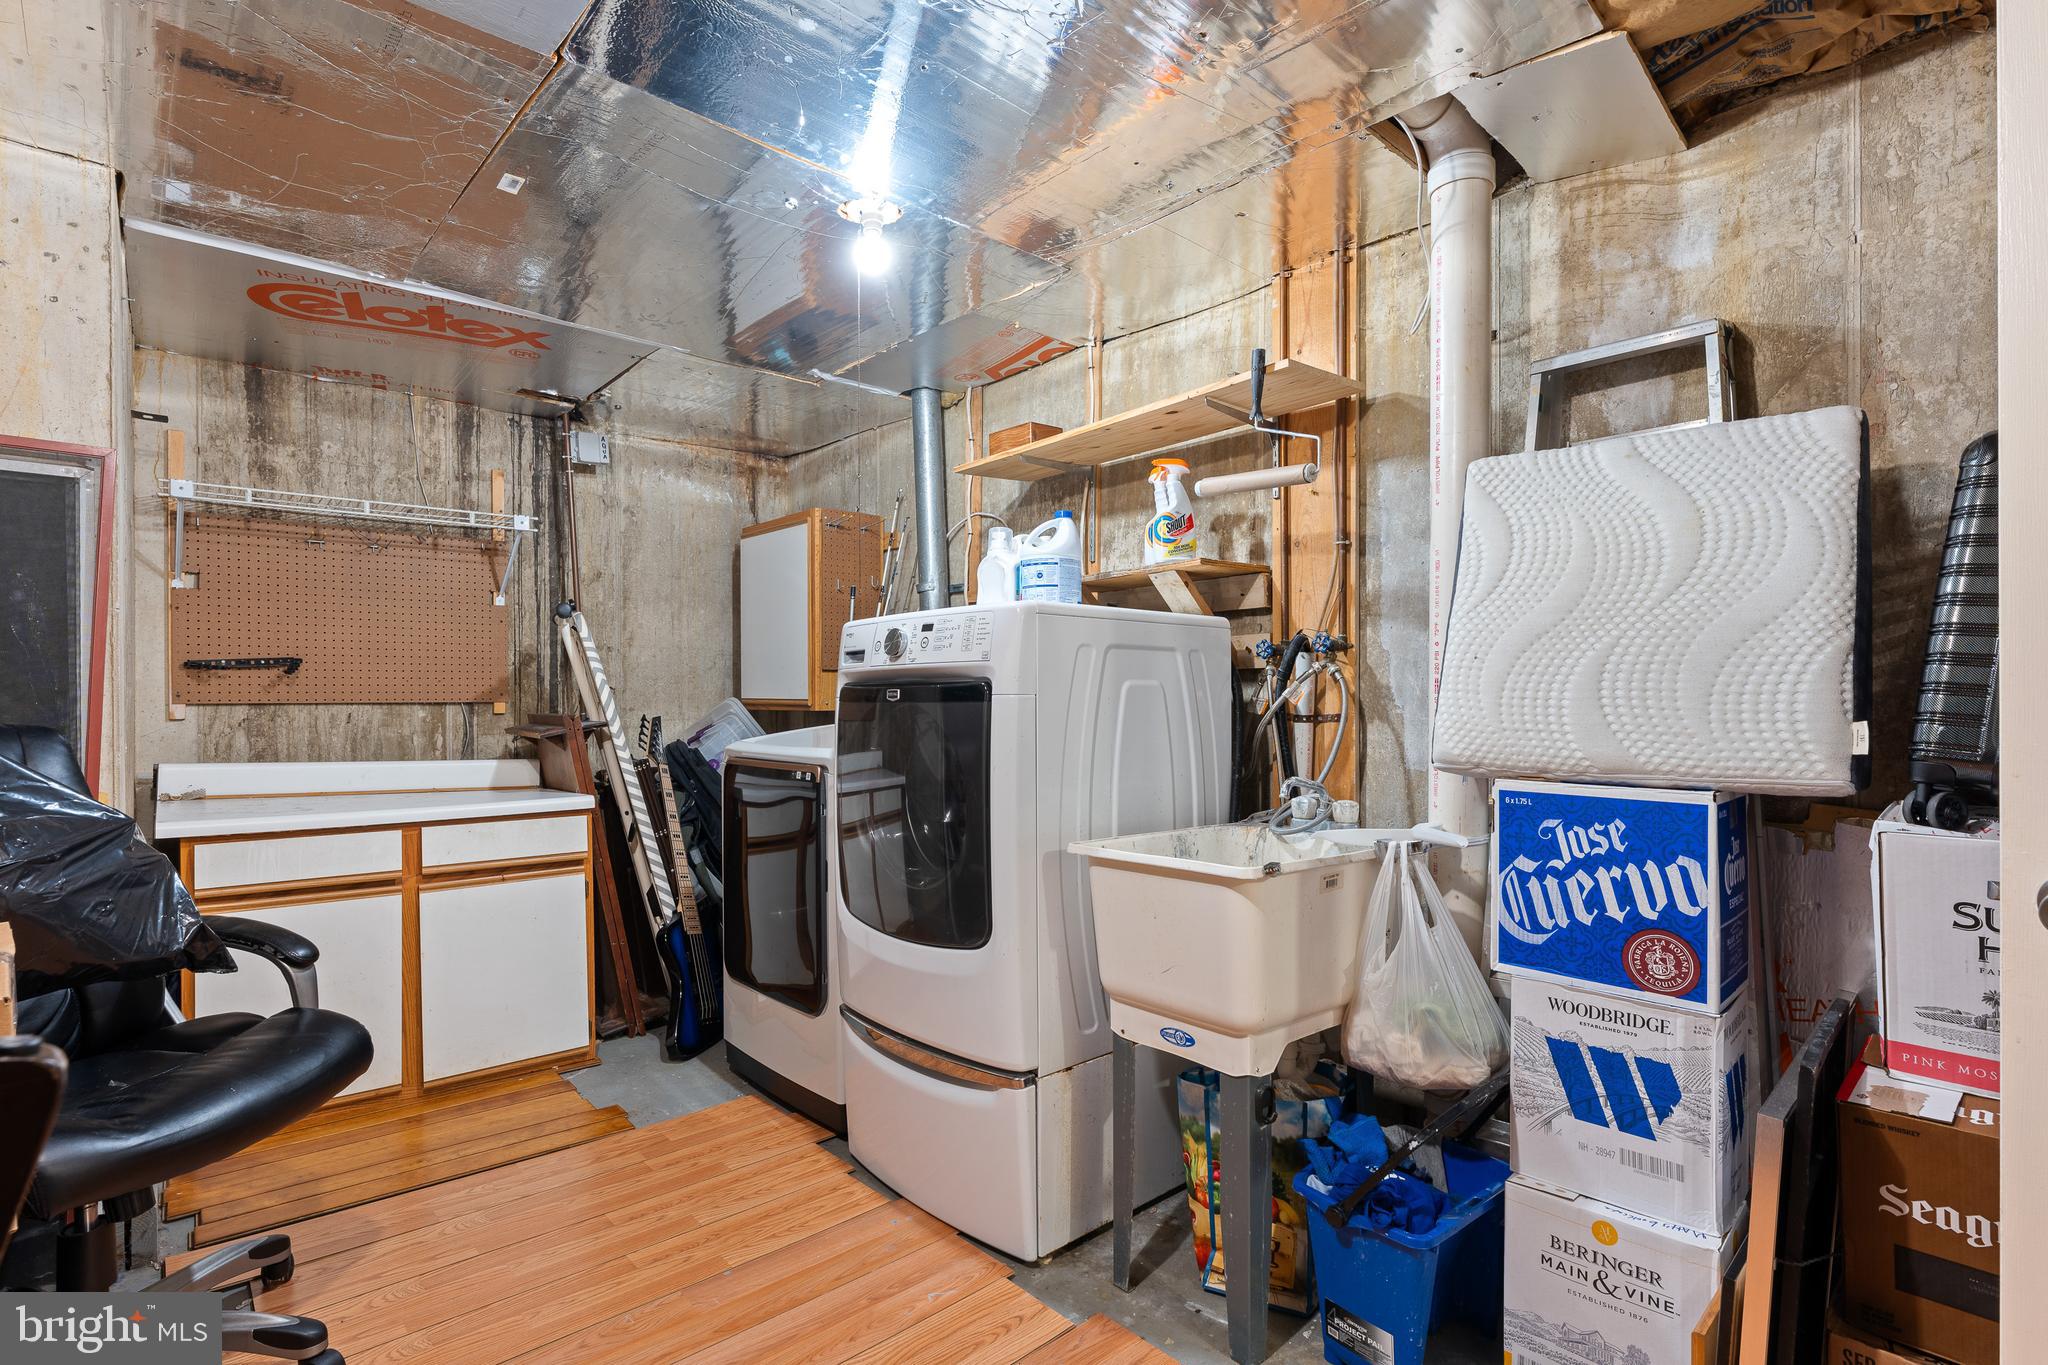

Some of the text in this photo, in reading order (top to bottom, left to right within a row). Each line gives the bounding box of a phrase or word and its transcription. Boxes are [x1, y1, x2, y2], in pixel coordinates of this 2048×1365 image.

[257, 268, 406, 296] INSULATING
[247, 283, 551, 350] Celotex
[1165, 514, 1186, 534] SHOUT
[1538, 818, 1629, 871] Jose
[1499, 854, 1708, 945] Cuervo
[1644, 974, 1683, 988] TEQUILA
[1547, 997, 1672, 1036] WOODBRIDGE
[1579, 1021, 1621, 1034] ESTABLISHED
[1902, 1052, 1947, 1071] PINK
[1887, 1124, 1921, 1137] WHISKEY
[1578, 1141, 1589, 1153] NH
[1595, 1146, 1616, 1159] 28947
[1550, 1234, 1664, 1290] BERINGER
[1541, 1253, 1675, 1315] MAIN & VINE
[1567, 1288, 1649, 1324] ESTABLISHED 1876
[1334, 1317, 1367, 1341] PROJECT
[1367, 1337, 1386, 1352] PAIL
